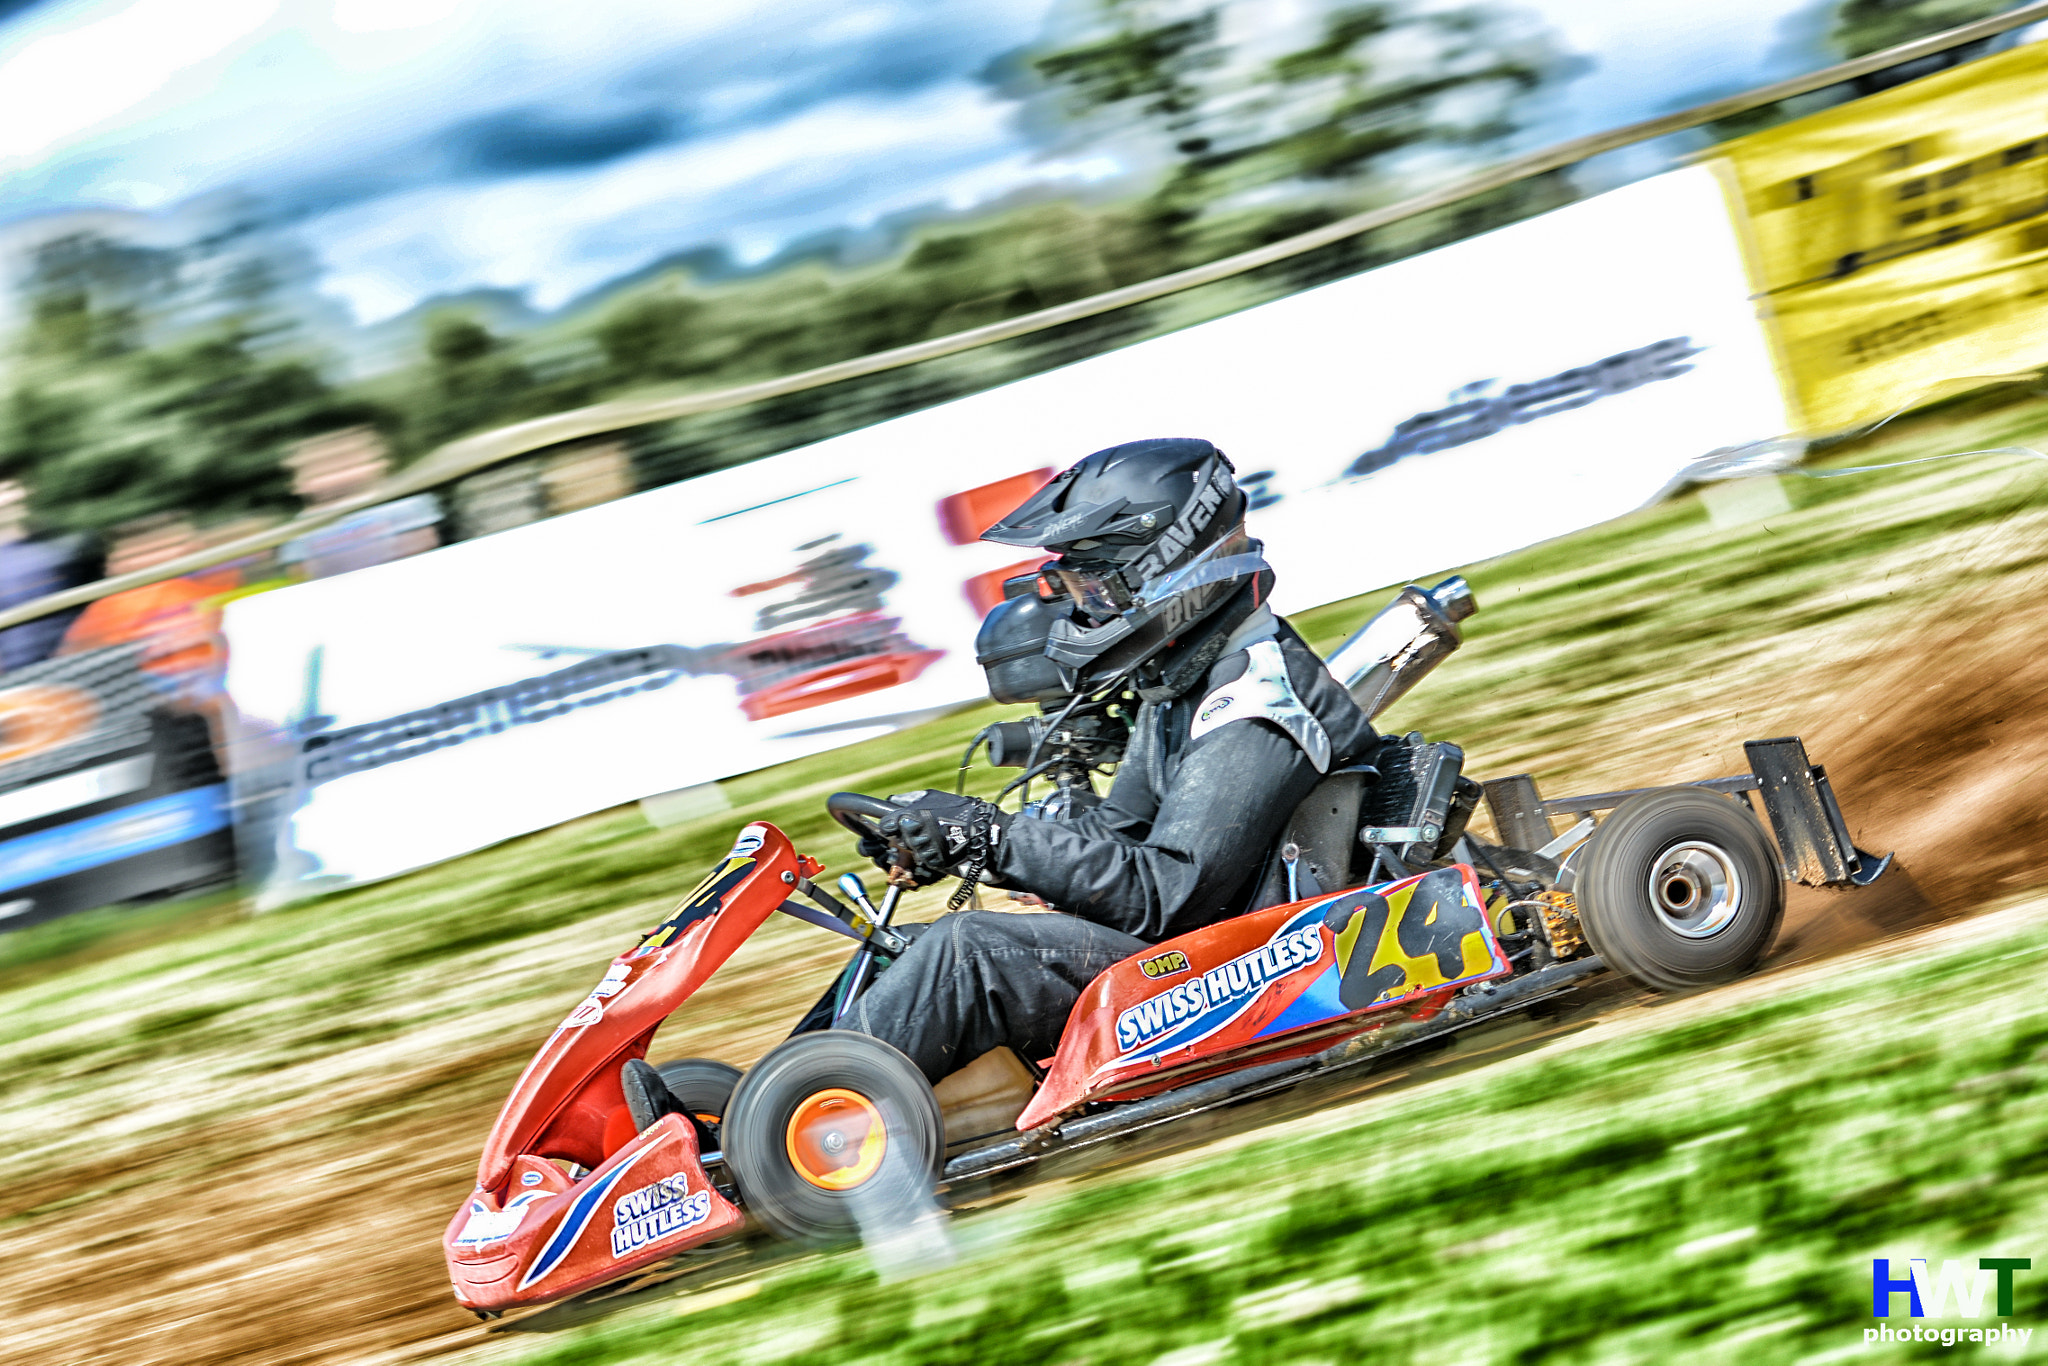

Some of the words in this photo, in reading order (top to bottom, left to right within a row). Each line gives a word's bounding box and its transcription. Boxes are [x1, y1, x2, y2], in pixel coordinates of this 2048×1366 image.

[1136, 483, 1222, 583] RAVEN
[1143, 952, 1186, 977] OMP
[1323, 868, 1483, 1011] 24
[1118, 979, 1205, 1049] SWISS
[1204, 925, 1322, 1009] HUTLESS
[613, 1193, 709, 1254] HUTLESS
[616, 1174, 687, 1226] SWISS
